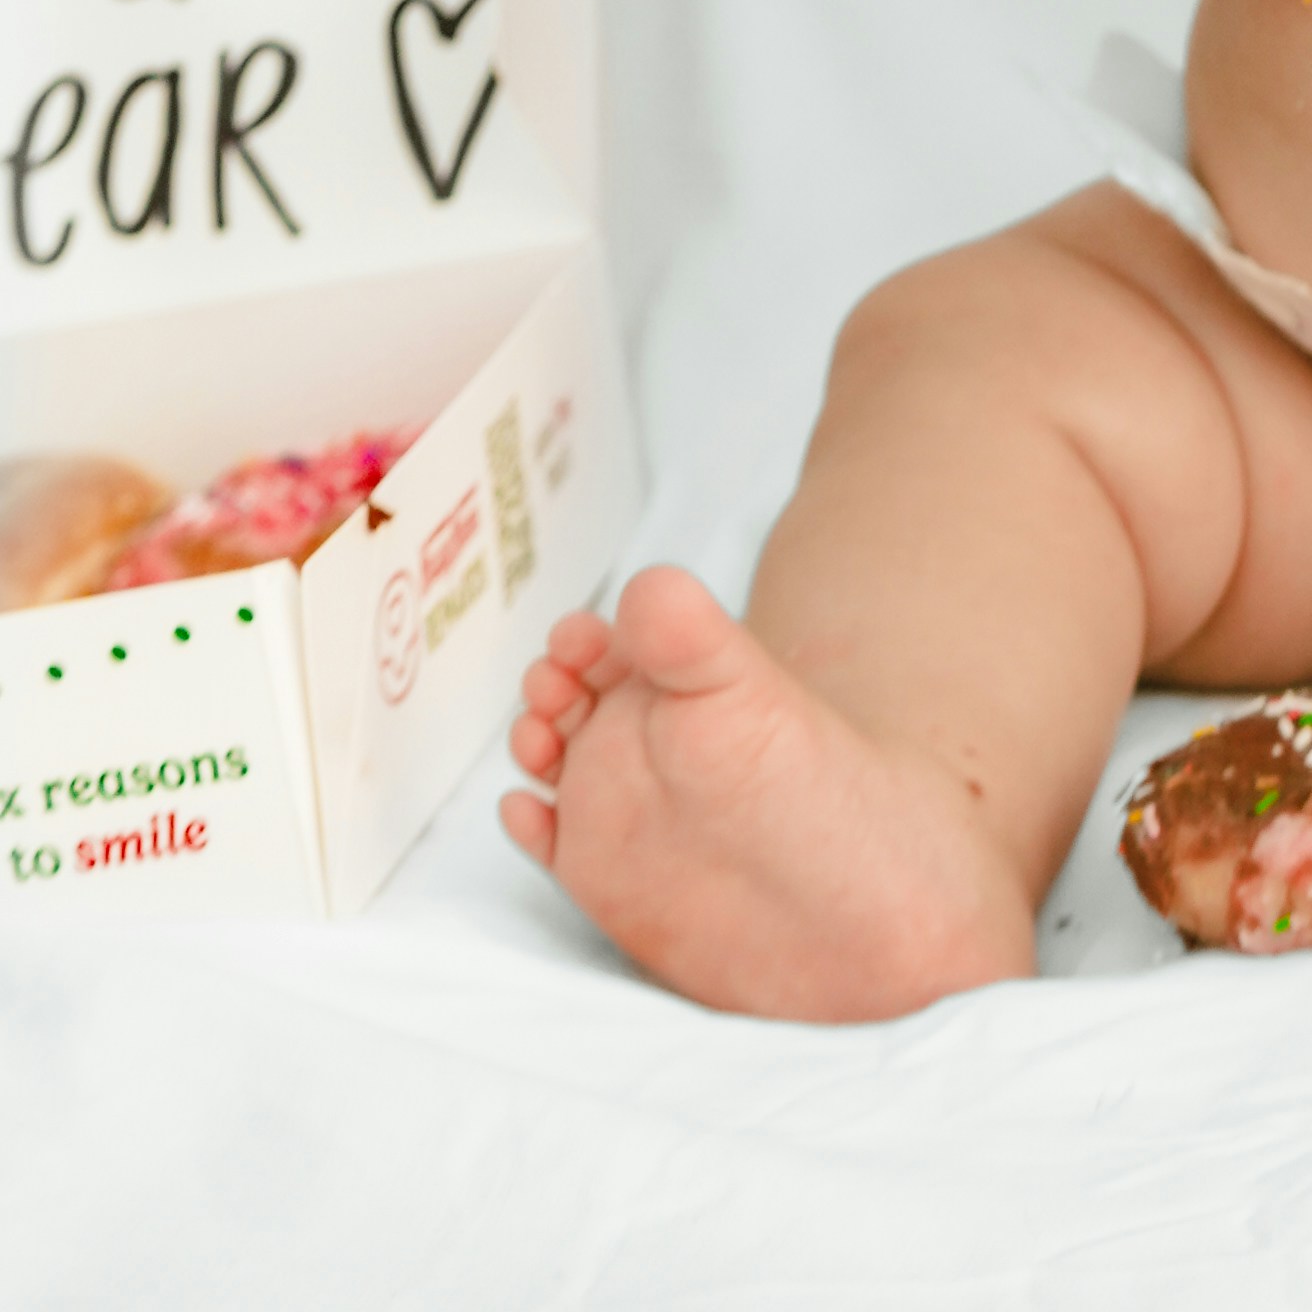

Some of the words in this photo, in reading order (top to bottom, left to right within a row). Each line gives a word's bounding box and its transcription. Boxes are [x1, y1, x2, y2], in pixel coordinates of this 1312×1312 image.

[41, 745, 249, 814] reasons
[10, 844, 61, 883] to
[74, 809, 208, 873] smile
